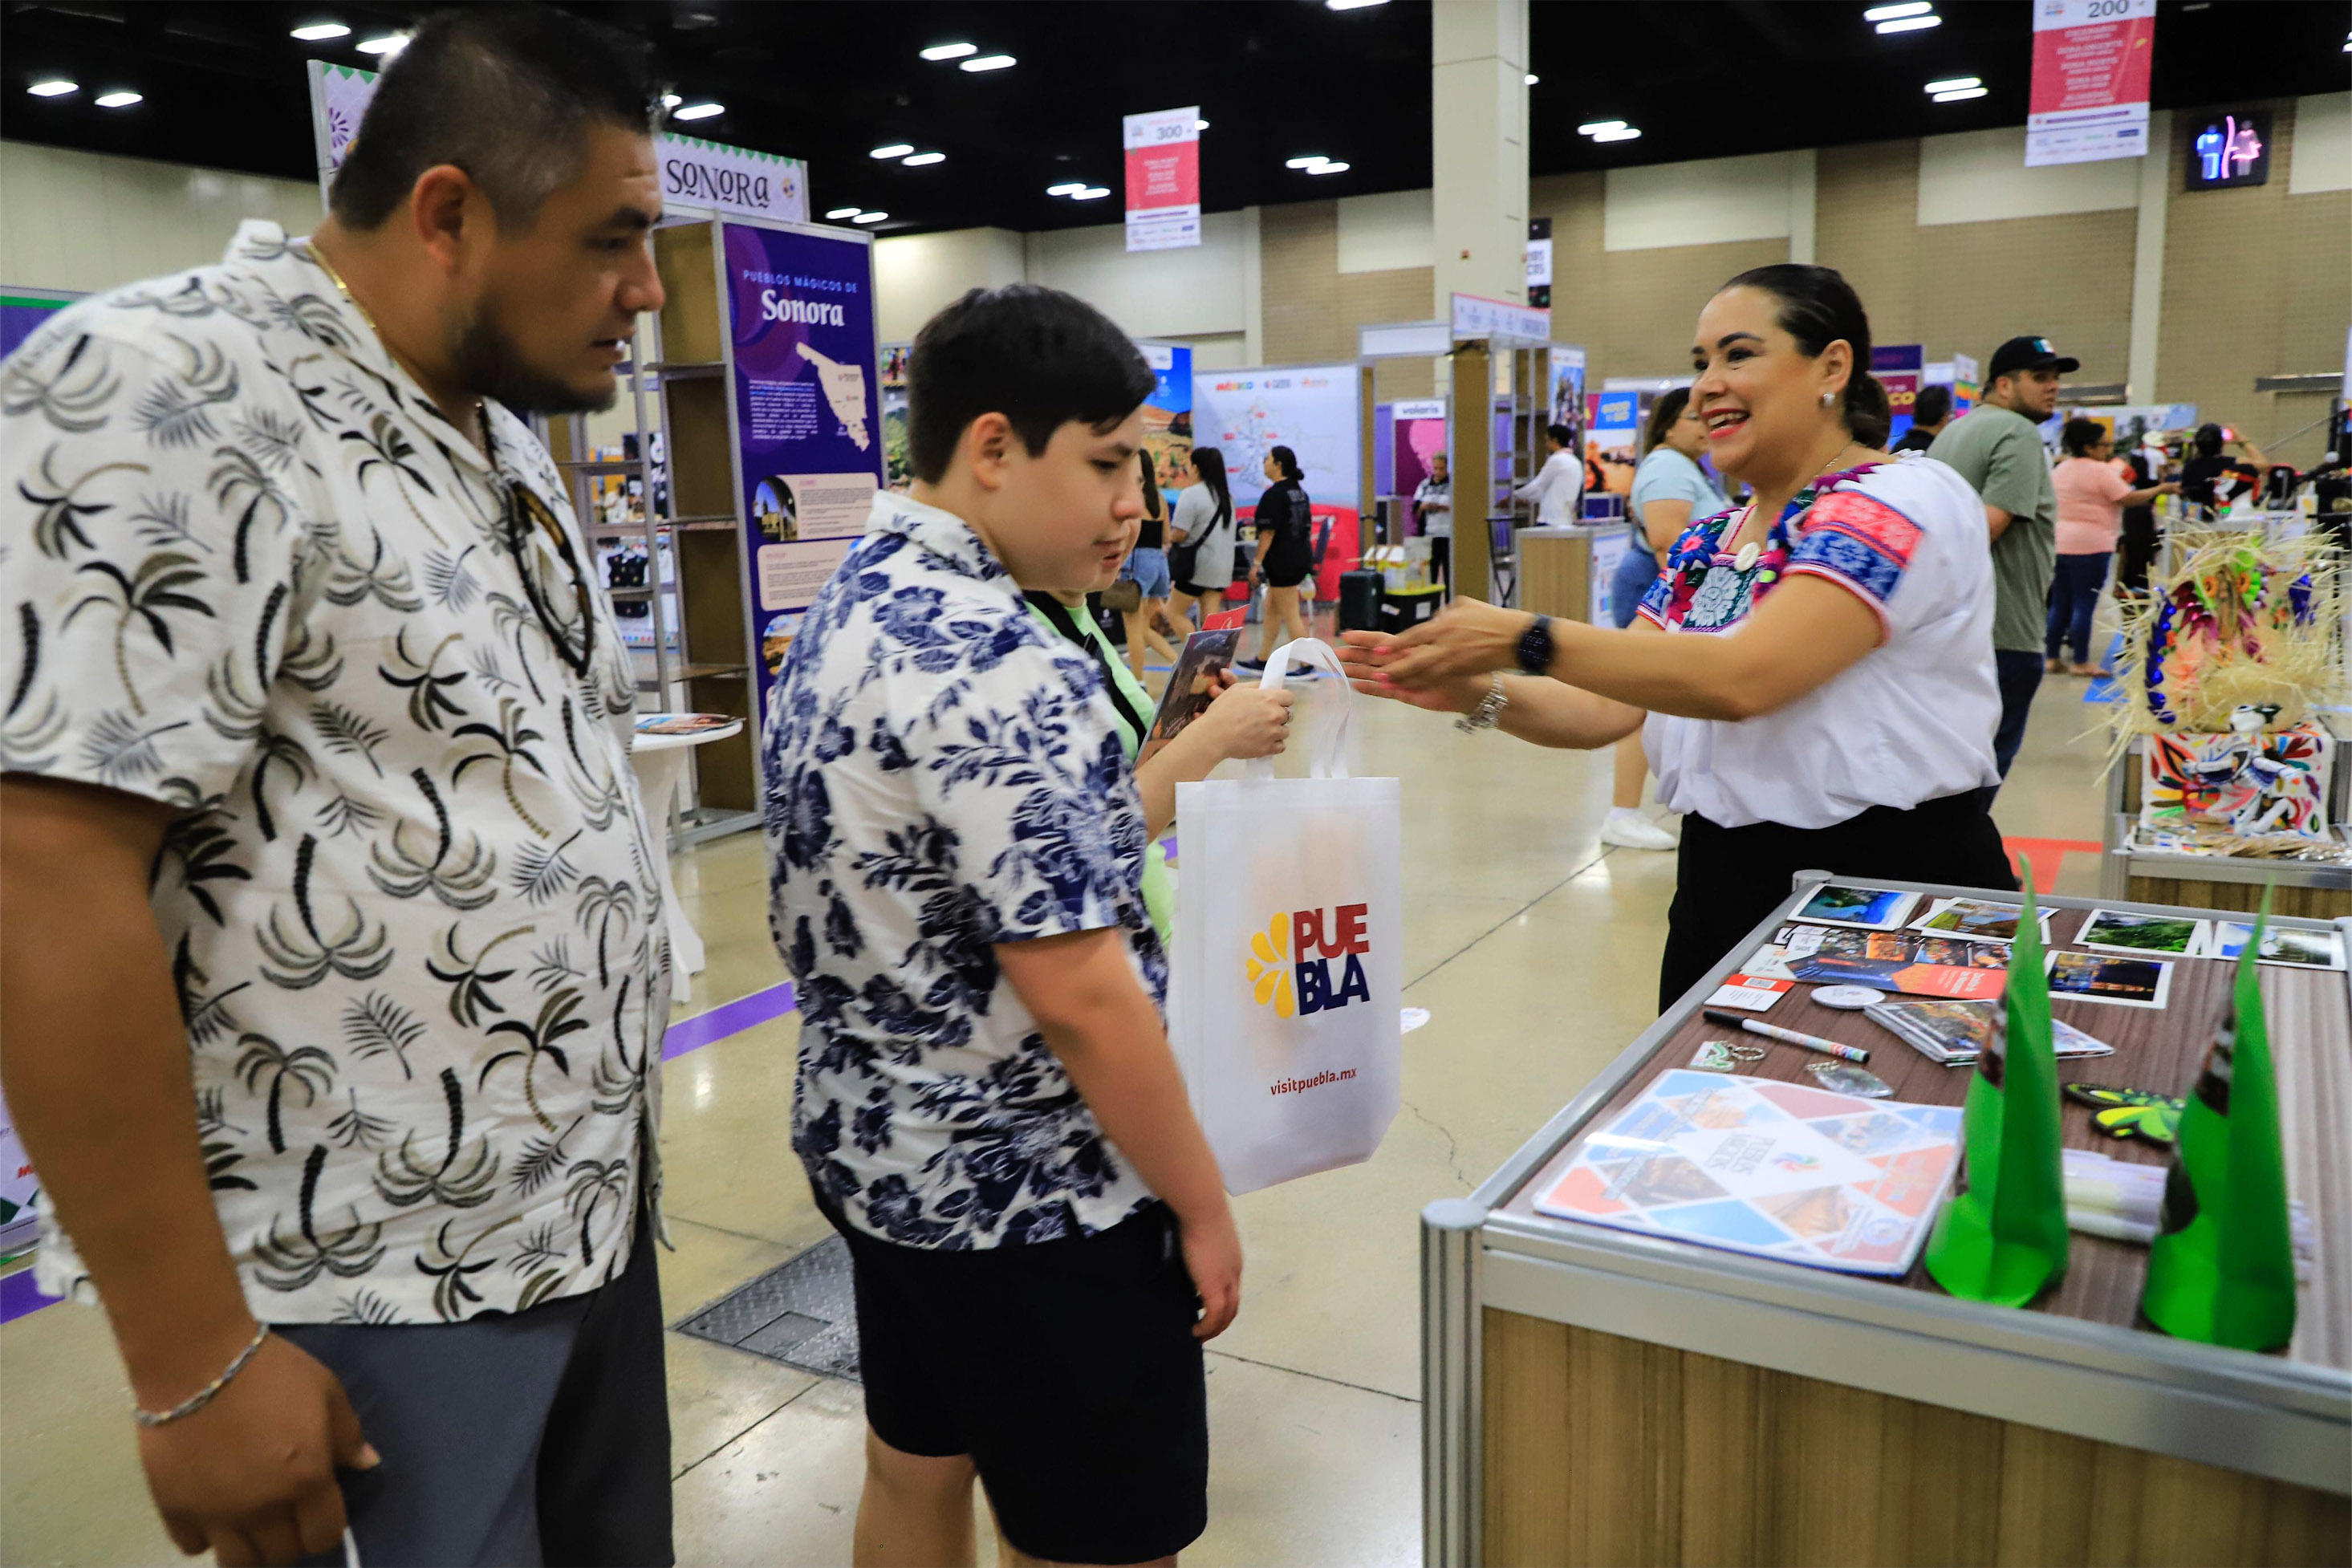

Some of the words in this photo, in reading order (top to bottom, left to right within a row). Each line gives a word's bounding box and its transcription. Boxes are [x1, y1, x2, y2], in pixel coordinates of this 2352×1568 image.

[2088, 0, 2129, 18] 200
[1157, 126, 1182, 140] 300
[743, 270, 790, 285] PUEBLOS
[794, 274, 842, 292] MÁGICOS
[845, 282, 858, 293] DE
[762, 289, 845, 327] Sonora
[1402, 404, 1439, 415] volaris
[1293, 903, 1370, 963] PUE
[1295, 953, 1370, 1016] BLA
[1270, 1068, 1357, 1095] visitpuebla.mx
